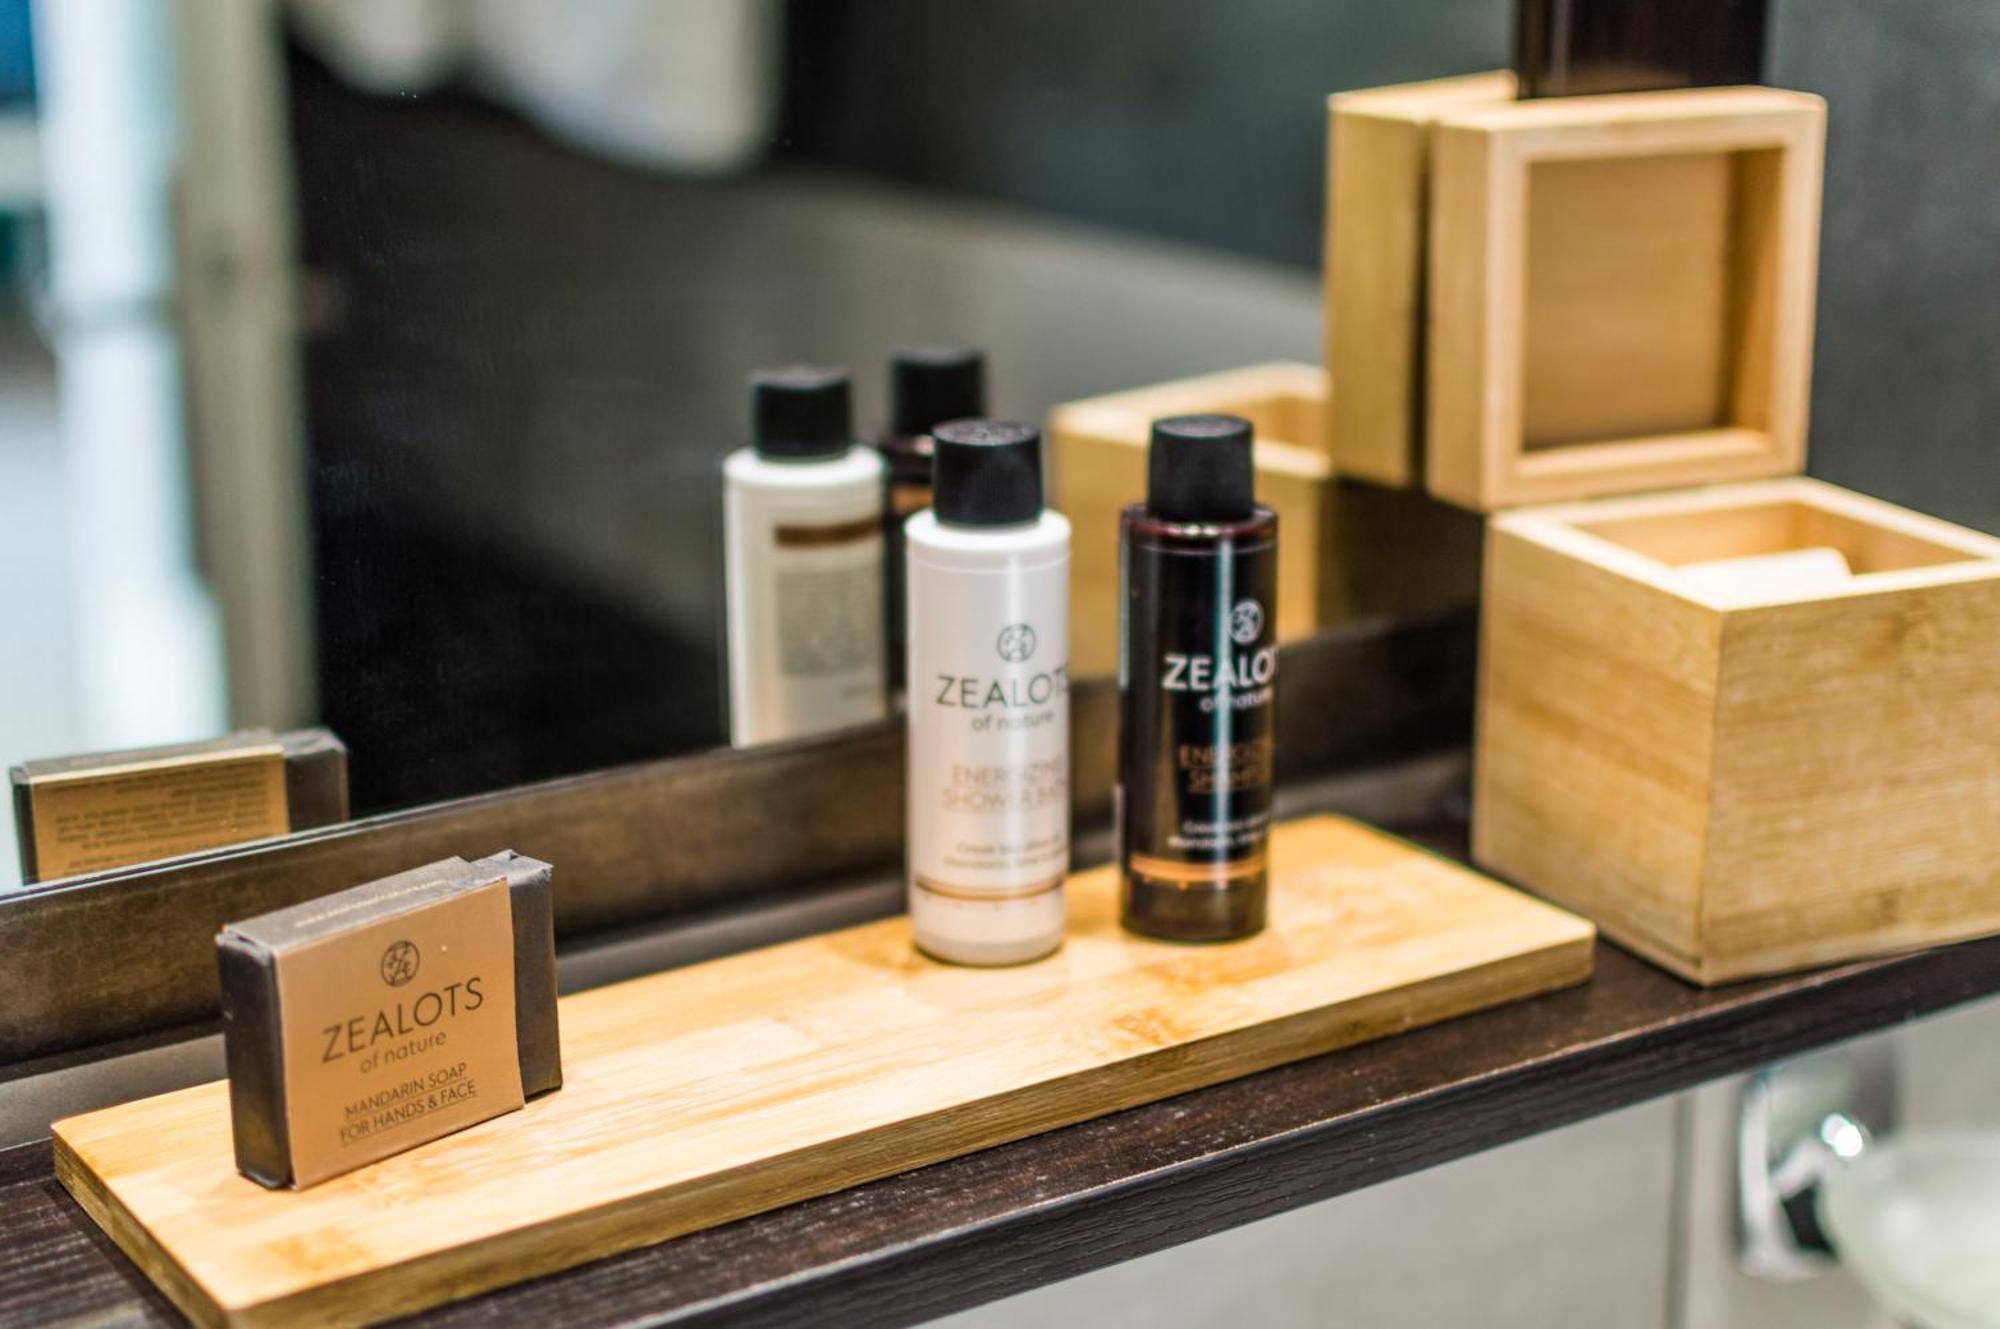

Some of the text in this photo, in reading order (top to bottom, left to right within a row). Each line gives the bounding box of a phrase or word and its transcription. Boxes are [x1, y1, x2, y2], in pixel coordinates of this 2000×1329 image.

[1163, 646, 1276, 691] ZEALO
[971, 712, 992, 732] of
[322, 976, 484, 1064] ZEALOTS
[360, 1031, 447, 1073] of nature
[340, 1079, 477, 1142] FOR HANDS & FACE
[344, 1062, 467, 1119] MANDARIN SOAP
